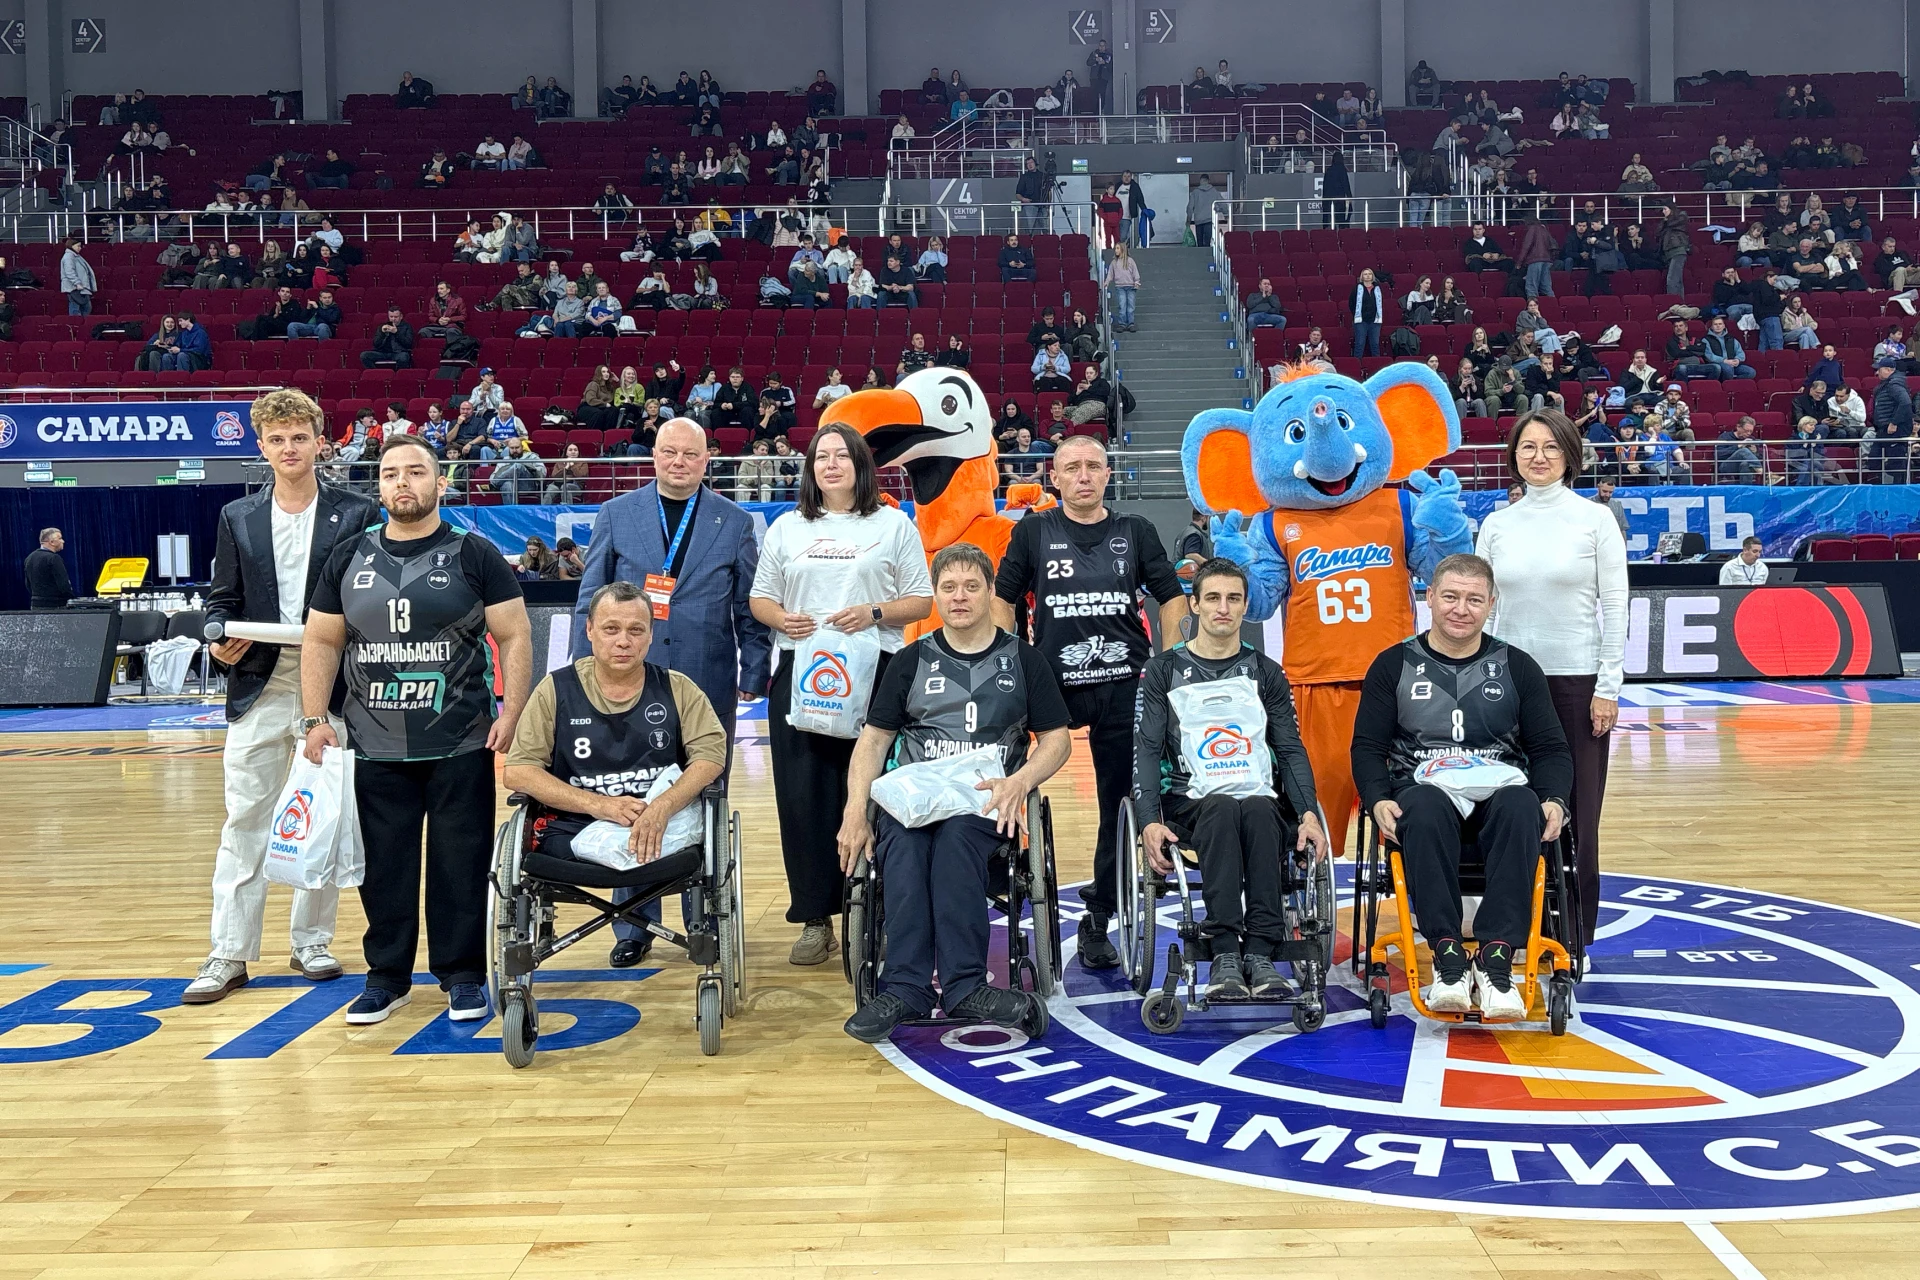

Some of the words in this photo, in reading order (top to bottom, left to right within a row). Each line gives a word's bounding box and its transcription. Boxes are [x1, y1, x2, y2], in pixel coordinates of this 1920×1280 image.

[1086, 13, 1096, 28] 4
[1149, 12, 1158, 27] 5
[16, 22, 25, 38] 3
[78, 22, 88, 37] 4
[958, 182, 972, 204] 4
[1313, 177, 1323, 199] 5
[953, 207, 977, 215] СЕКТОР
[1245, 400, 1250, 408] 6
[36, 415, 194, 443] САМАРА
[1046, 559, 1074, 579] 23
[1295, 543, 1393, 583] Самара
[430, 575, 448, 583] РФБ
[1045, 591, 1130, 607] СЫЗРАНЬ
[1316, 578, 1372, 625] 63
[387, 598, 411, 633] 13
[1053, 604, 1126, 618] БАСКЕТ
[1062, 665, 1132, 680] РОССИЙСКИЙ
[369, 681, 436, 700] ПАРИ
[1484, 687, 1501, 695] РФБ
[375, 699, 432, 709] ПОБЕЖДАЙ
[802, 699, 843, 710] САМАРА
[965, 701, 977, 733] 9
[1451, 709, 1465, 742] 8
[574, 737, 592, 759] 8
[1205, 760, 1250, 770] САМАРА
[569, 765, 669, 788] СЫЗРАН
[271, 842, 298, 854] САМАРА
[1619, 885, 1811, 922] ВТБ
[1676, 950, 1778, 962] ВТБ
[1044, 1076, 1676, 1186] ПАМЯТИ
